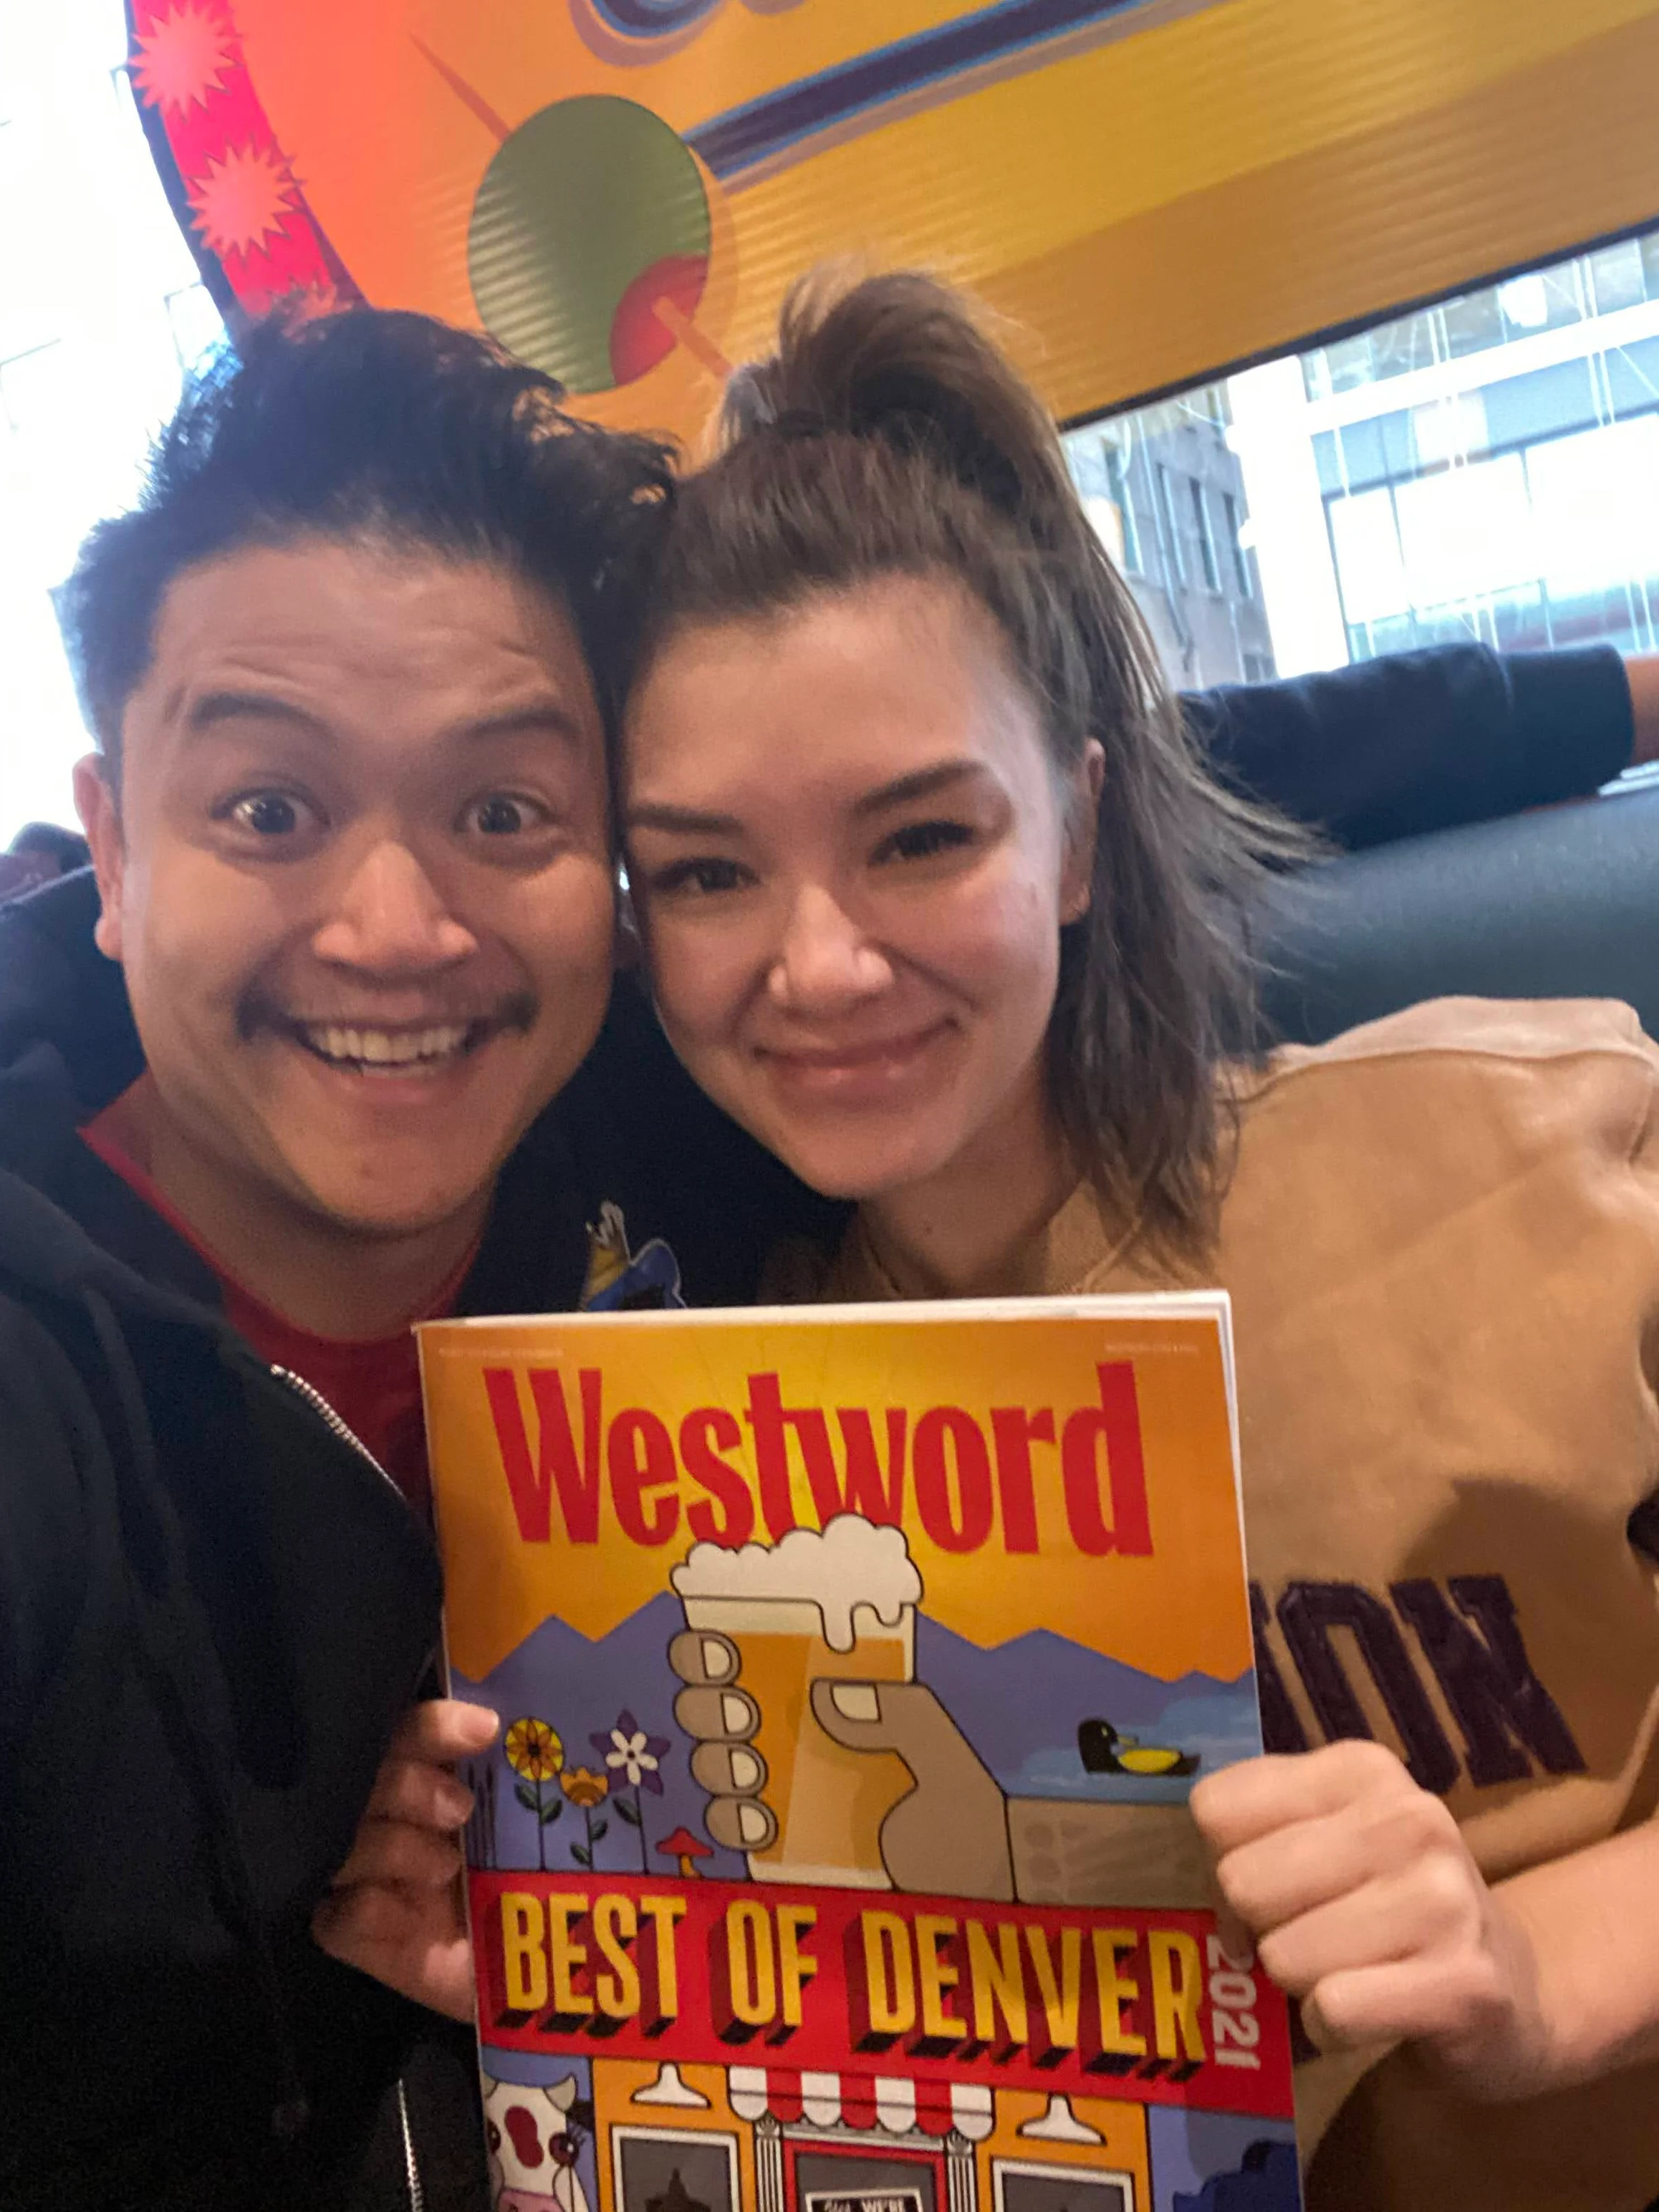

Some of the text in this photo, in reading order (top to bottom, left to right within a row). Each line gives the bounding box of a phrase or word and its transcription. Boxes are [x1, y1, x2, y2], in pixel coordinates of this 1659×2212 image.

[483, 1361, 1153, 1557] Westword
[501, 1891, 1206, 2063] BEST OF DENVER
[1207, 1935, 1260, 2071] 2021
